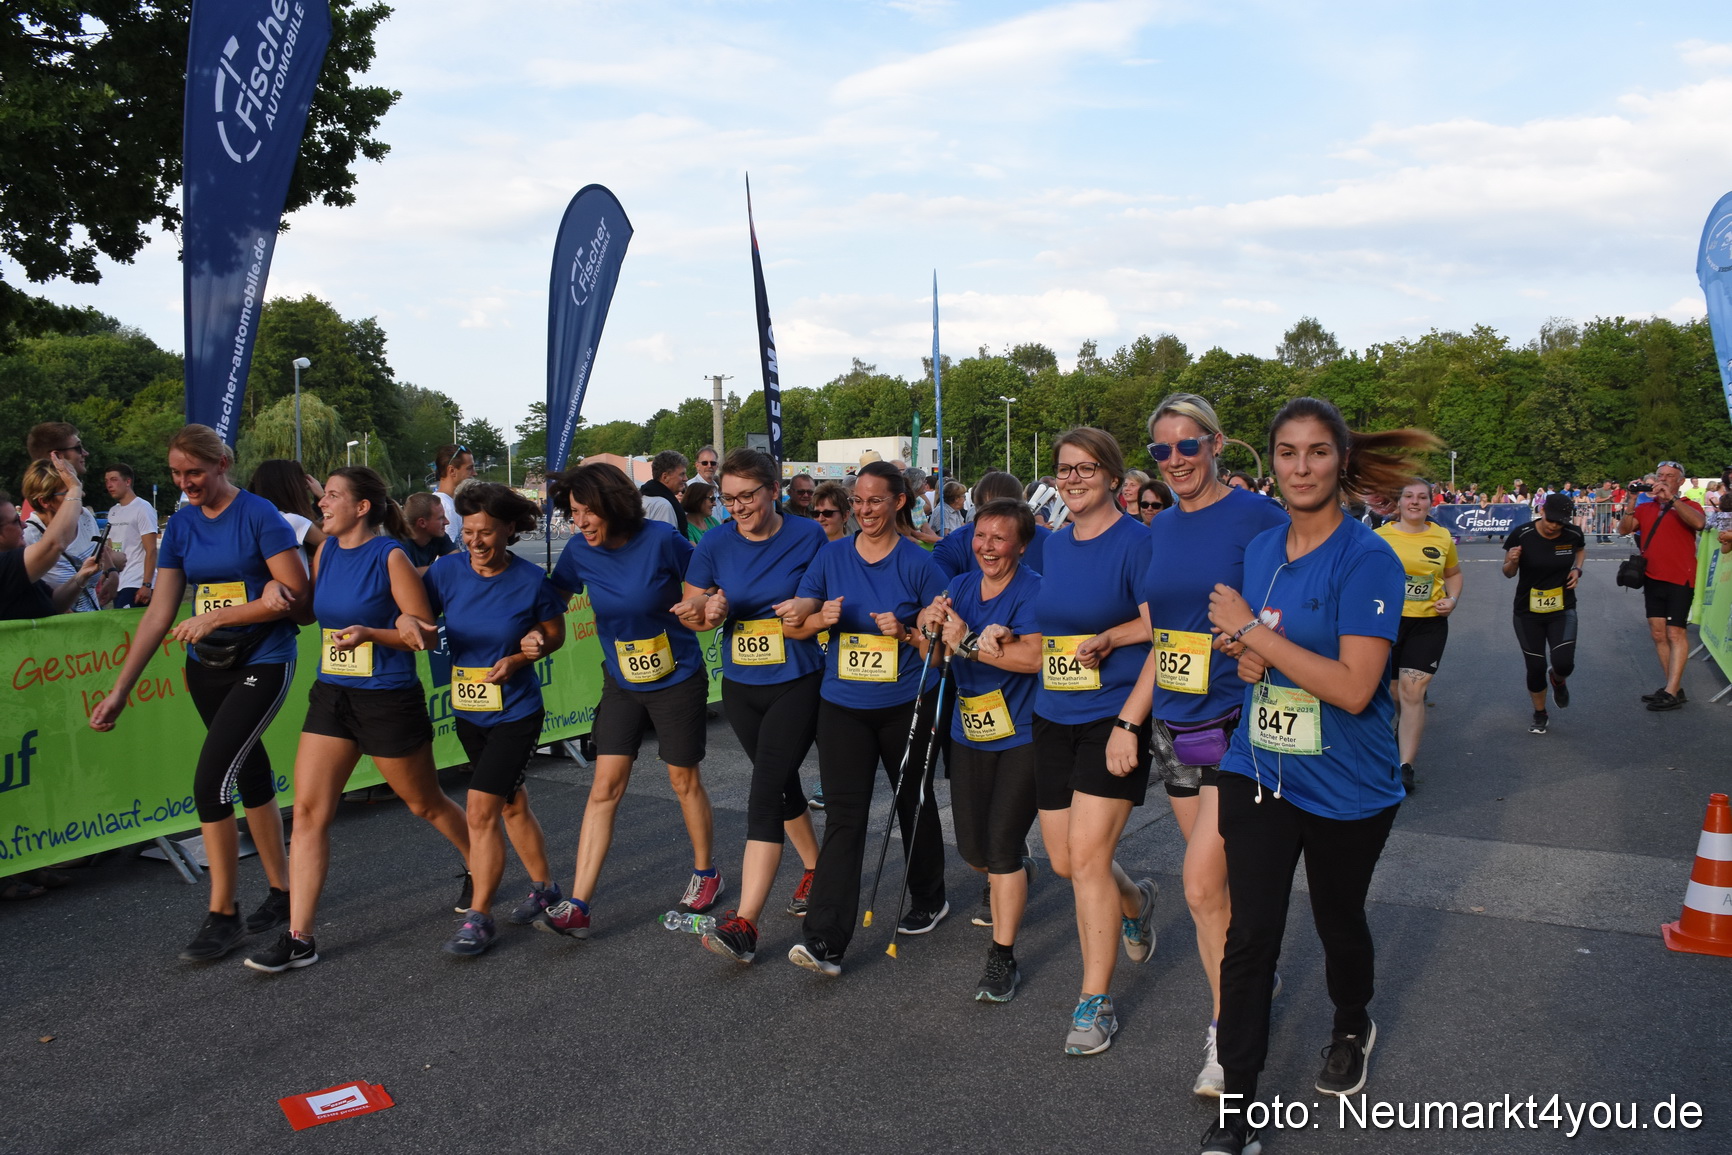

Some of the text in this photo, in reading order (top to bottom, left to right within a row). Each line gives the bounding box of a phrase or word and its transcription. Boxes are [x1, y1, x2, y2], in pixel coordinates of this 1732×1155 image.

[265, 2, 305, 131] AUTOMOBILE
[579, 217, 607, 293] Fischer
[589, 231, 611, 292] AUTOMOBILE
[1466, 516, 1513, 527] Fischer
[1406, 584, 1429, 595] 762
[1537, 596, 1557, 607] 142
[737, 636, 770, 653] 868
[330, 646, 355, 664] 861
[628, 653, 661, 672] 866
[849, 650, 883, 668] 872
[1160, 651, 1191, 676] 852
[1048, 655, 1082, 675] 864
[457, 682, 487, 699] 862
[962, 711, 996, 730] 854
[1257, 706, 1298, 736] 847
[1260, 731, 1297, 743] Ascher Peter
